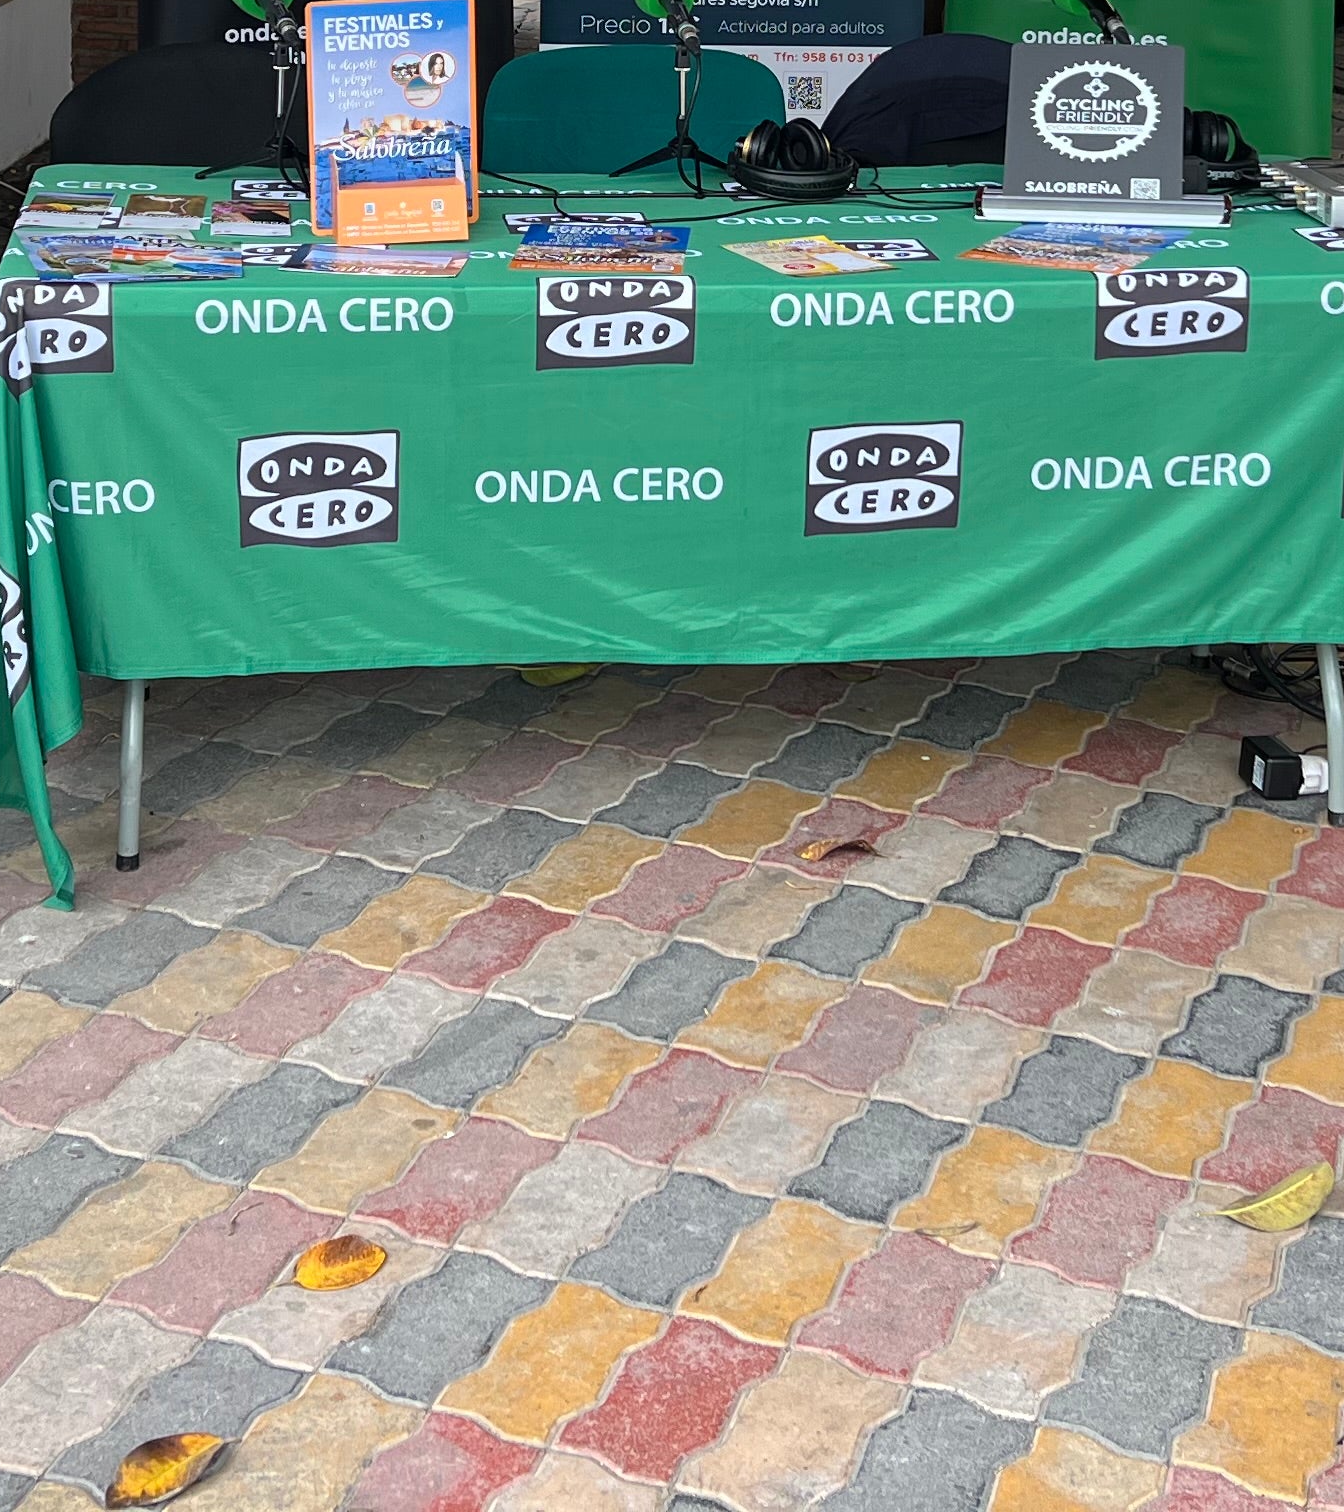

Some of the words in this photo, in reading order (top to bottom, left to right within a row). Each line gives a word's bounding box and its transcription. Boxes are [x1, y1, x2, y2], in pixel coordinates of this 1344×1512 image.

[323, 12, 433, 34] FESTIVALES
[580, 16, 650, 35] Precio
[718, 20, 788, 33] Actividad
[793, 22, 826, 35] para
[830, 22, 884, 35] adultos
[325, 32, 410, 52] EVENTOS
[774, 53, 798, 62] Tfn:
[802, 53, 825, 62] 958
[830, 53, 843, 62] 61
[847, 53, 864, 62] 03
[1056, 99, 1135, 112] CYCLING
[1056, 111, 1134, 124] FRIENDLY
[333, 134, 452, 161] Salobreña
[57, 180, 157, 190] CERO
[1025, 179, 1122, 195] SALOBREÑA
[716, 216, 830, 225] ONDA
[838, 215, 938, 223] CERO
[559, 276, 673, 303] ONDA
[1119, 271, 1226, 292] ONDA
[195, 298, 328, 336] ONDA
[338, 296, 454, 333] CERO
[770, 290, 894, 328] ONDA
[905, 289, 1015, 324] CERO
[565, 322, 670, 348] CERO
[1125, 311, 1225, 337] CERO
[259, 455, 375, 484] ONDA
[829, 446, 937, 471] ONDA
[1030, 458, 1154, 491] ONDA
[1164, 453, 1271, 486] CERO
[48, 479, 155, 515] CERO
[475, 470, 601, 504] ONDA
[613, 467, 723, 501] CERO
[270, 499, 374, 530] CERO
[834, 488, 935, 516] CERO
